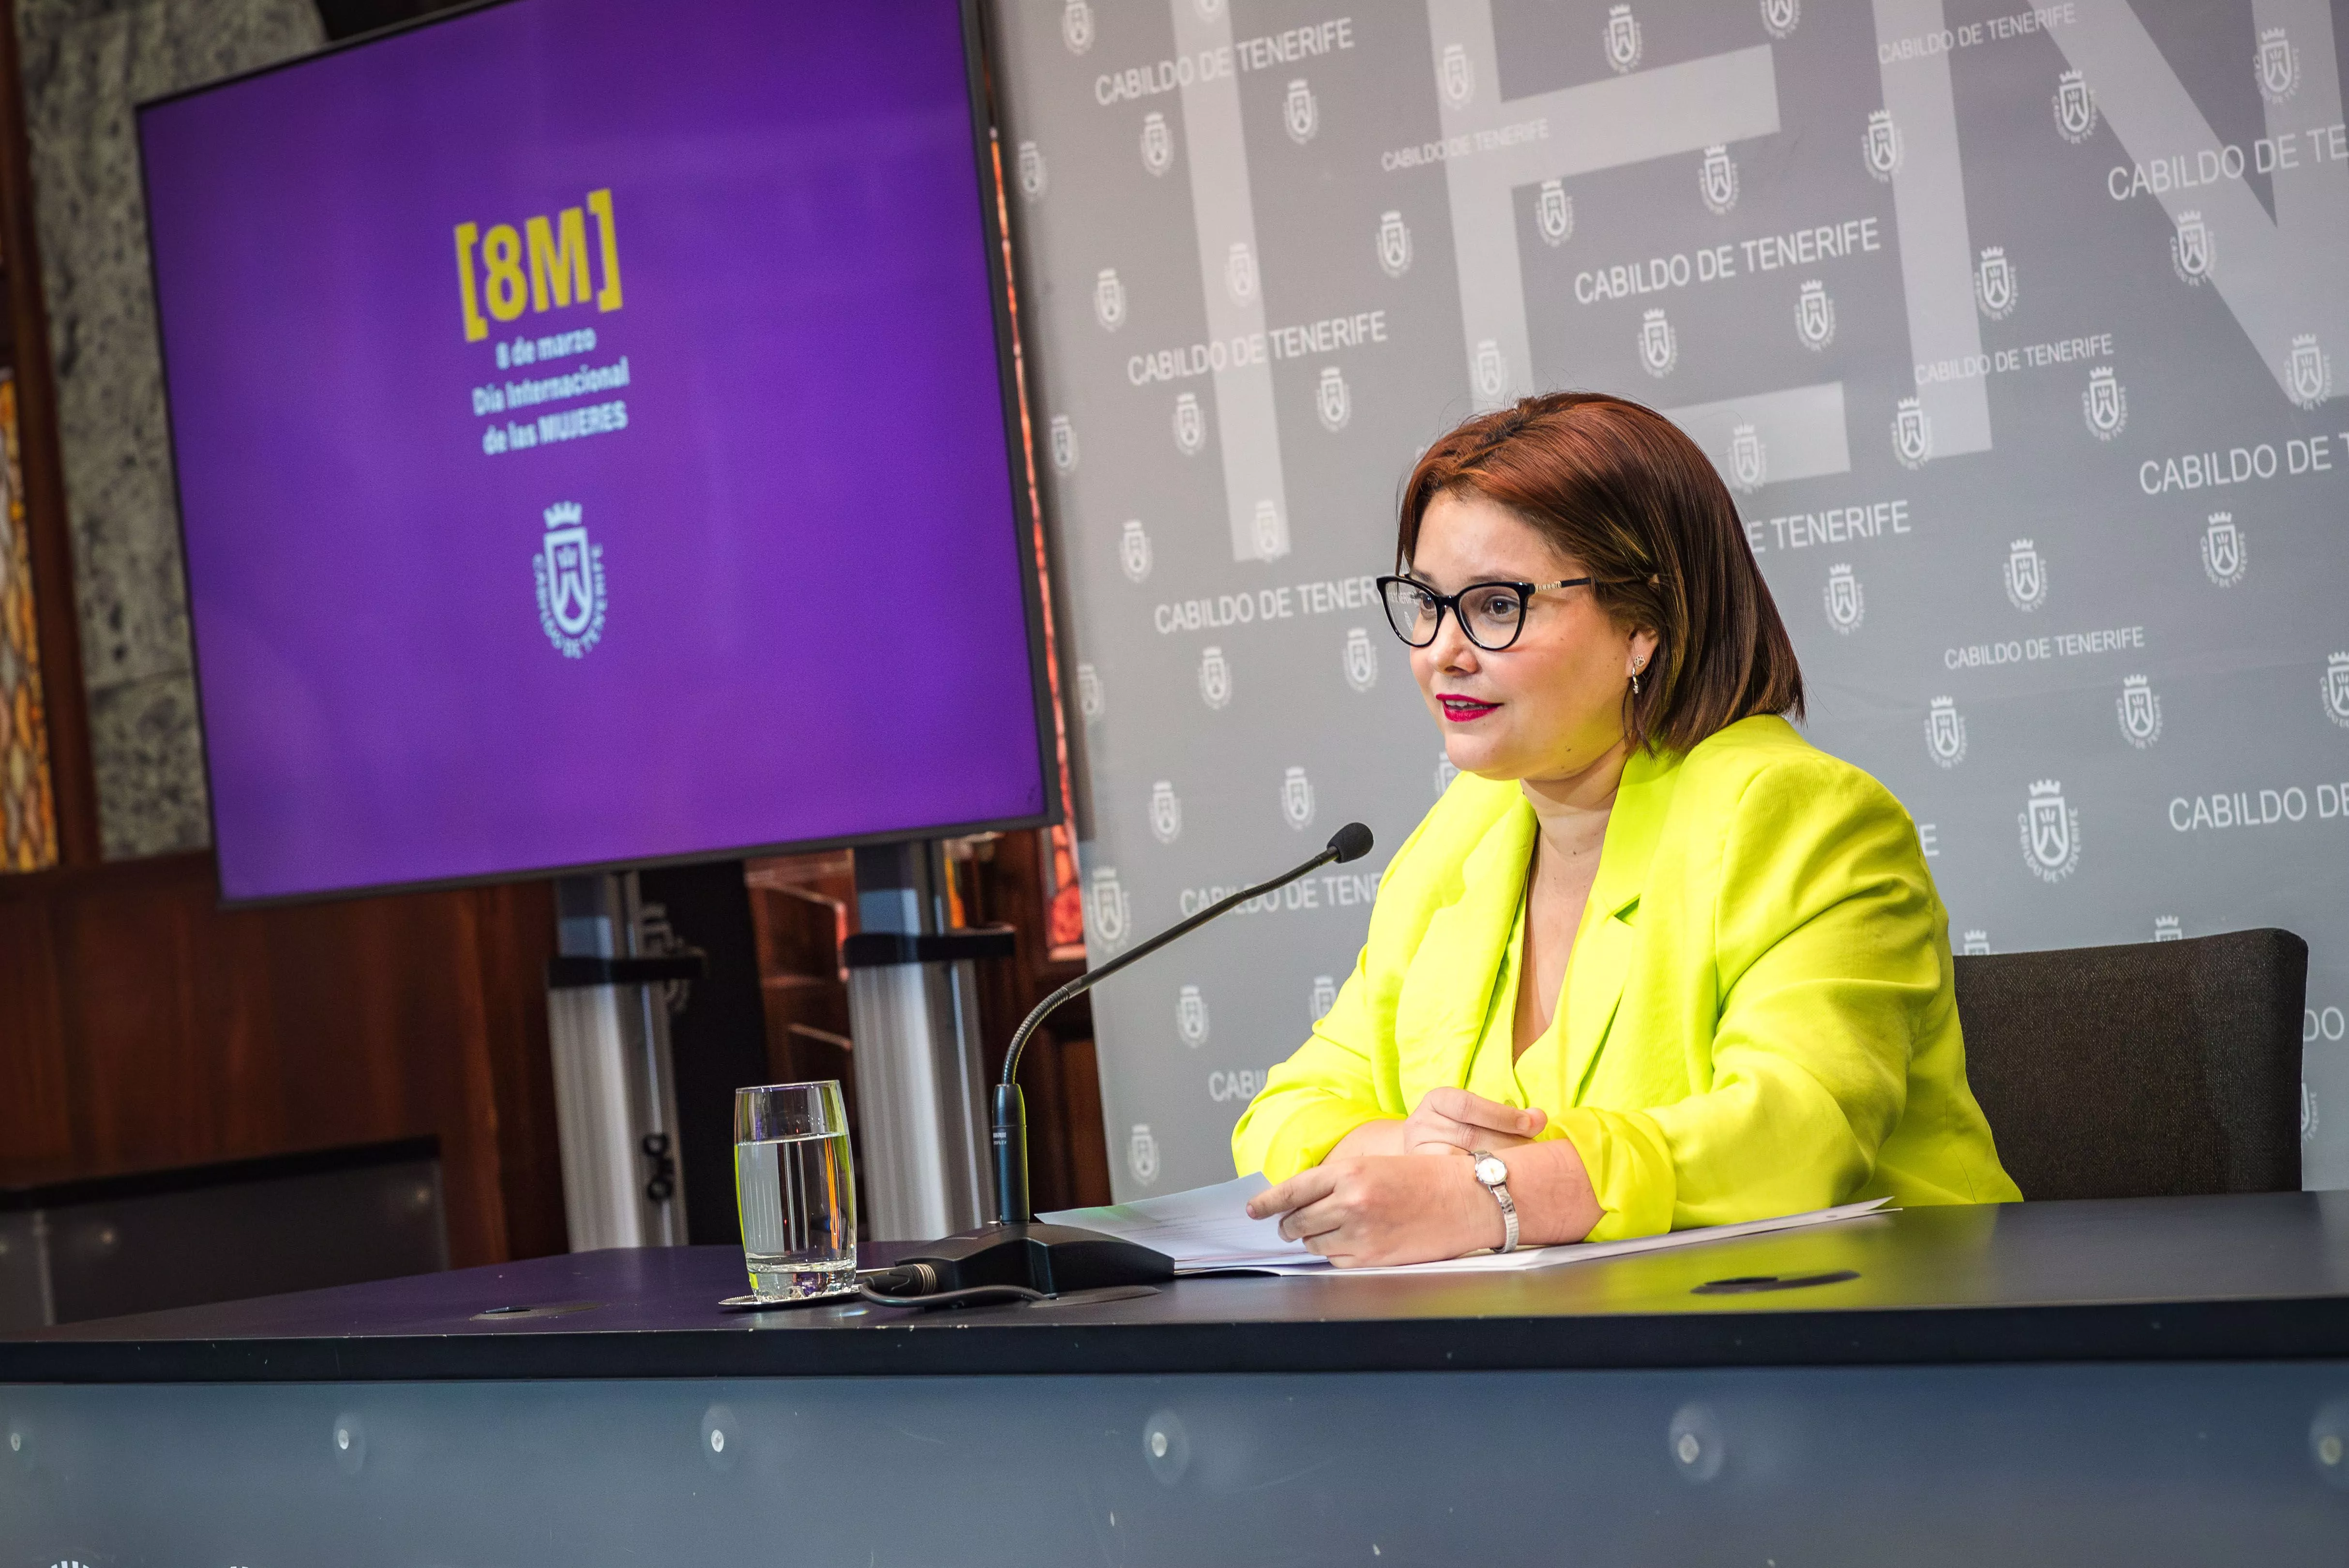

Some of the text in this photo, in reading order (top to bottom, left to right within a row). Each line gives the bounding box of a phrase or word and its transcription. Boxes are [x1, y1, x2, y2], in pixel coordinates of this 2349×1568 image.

[1095, 17, 1354, 106] CABILDO DE TENERIFE
[1877, 3, 2076, 64] CABILDO DE TENERIFE
[2108, 145, 2245, 201] CABILDO
[2255, 133, 2299, 174] DE
[454, 188, 623, 343] [8M]
[1575, 217, 1881, 304] CABILDO DE TENERIFE
[1128, 310, 1387, 385] CABILDO DE TENERIFE
[1914, 333, 2114, 385] CABILDO DE TENERIFE
[2139, 443, 2276, 496] CABILDO
[2287, 436, 2332, 474] DE
[1770, 499, 1911, 550] TENERIFE
[1154, 592, 1254, 634] CABILDO
[1258, 587, 1293, 620] DE
[1945, 626, 2145, 669] CABILDO DE TENERIFE
[2168, 787, 2307, 831] CABILDO
[1285, 877, 1319, 910] DE
